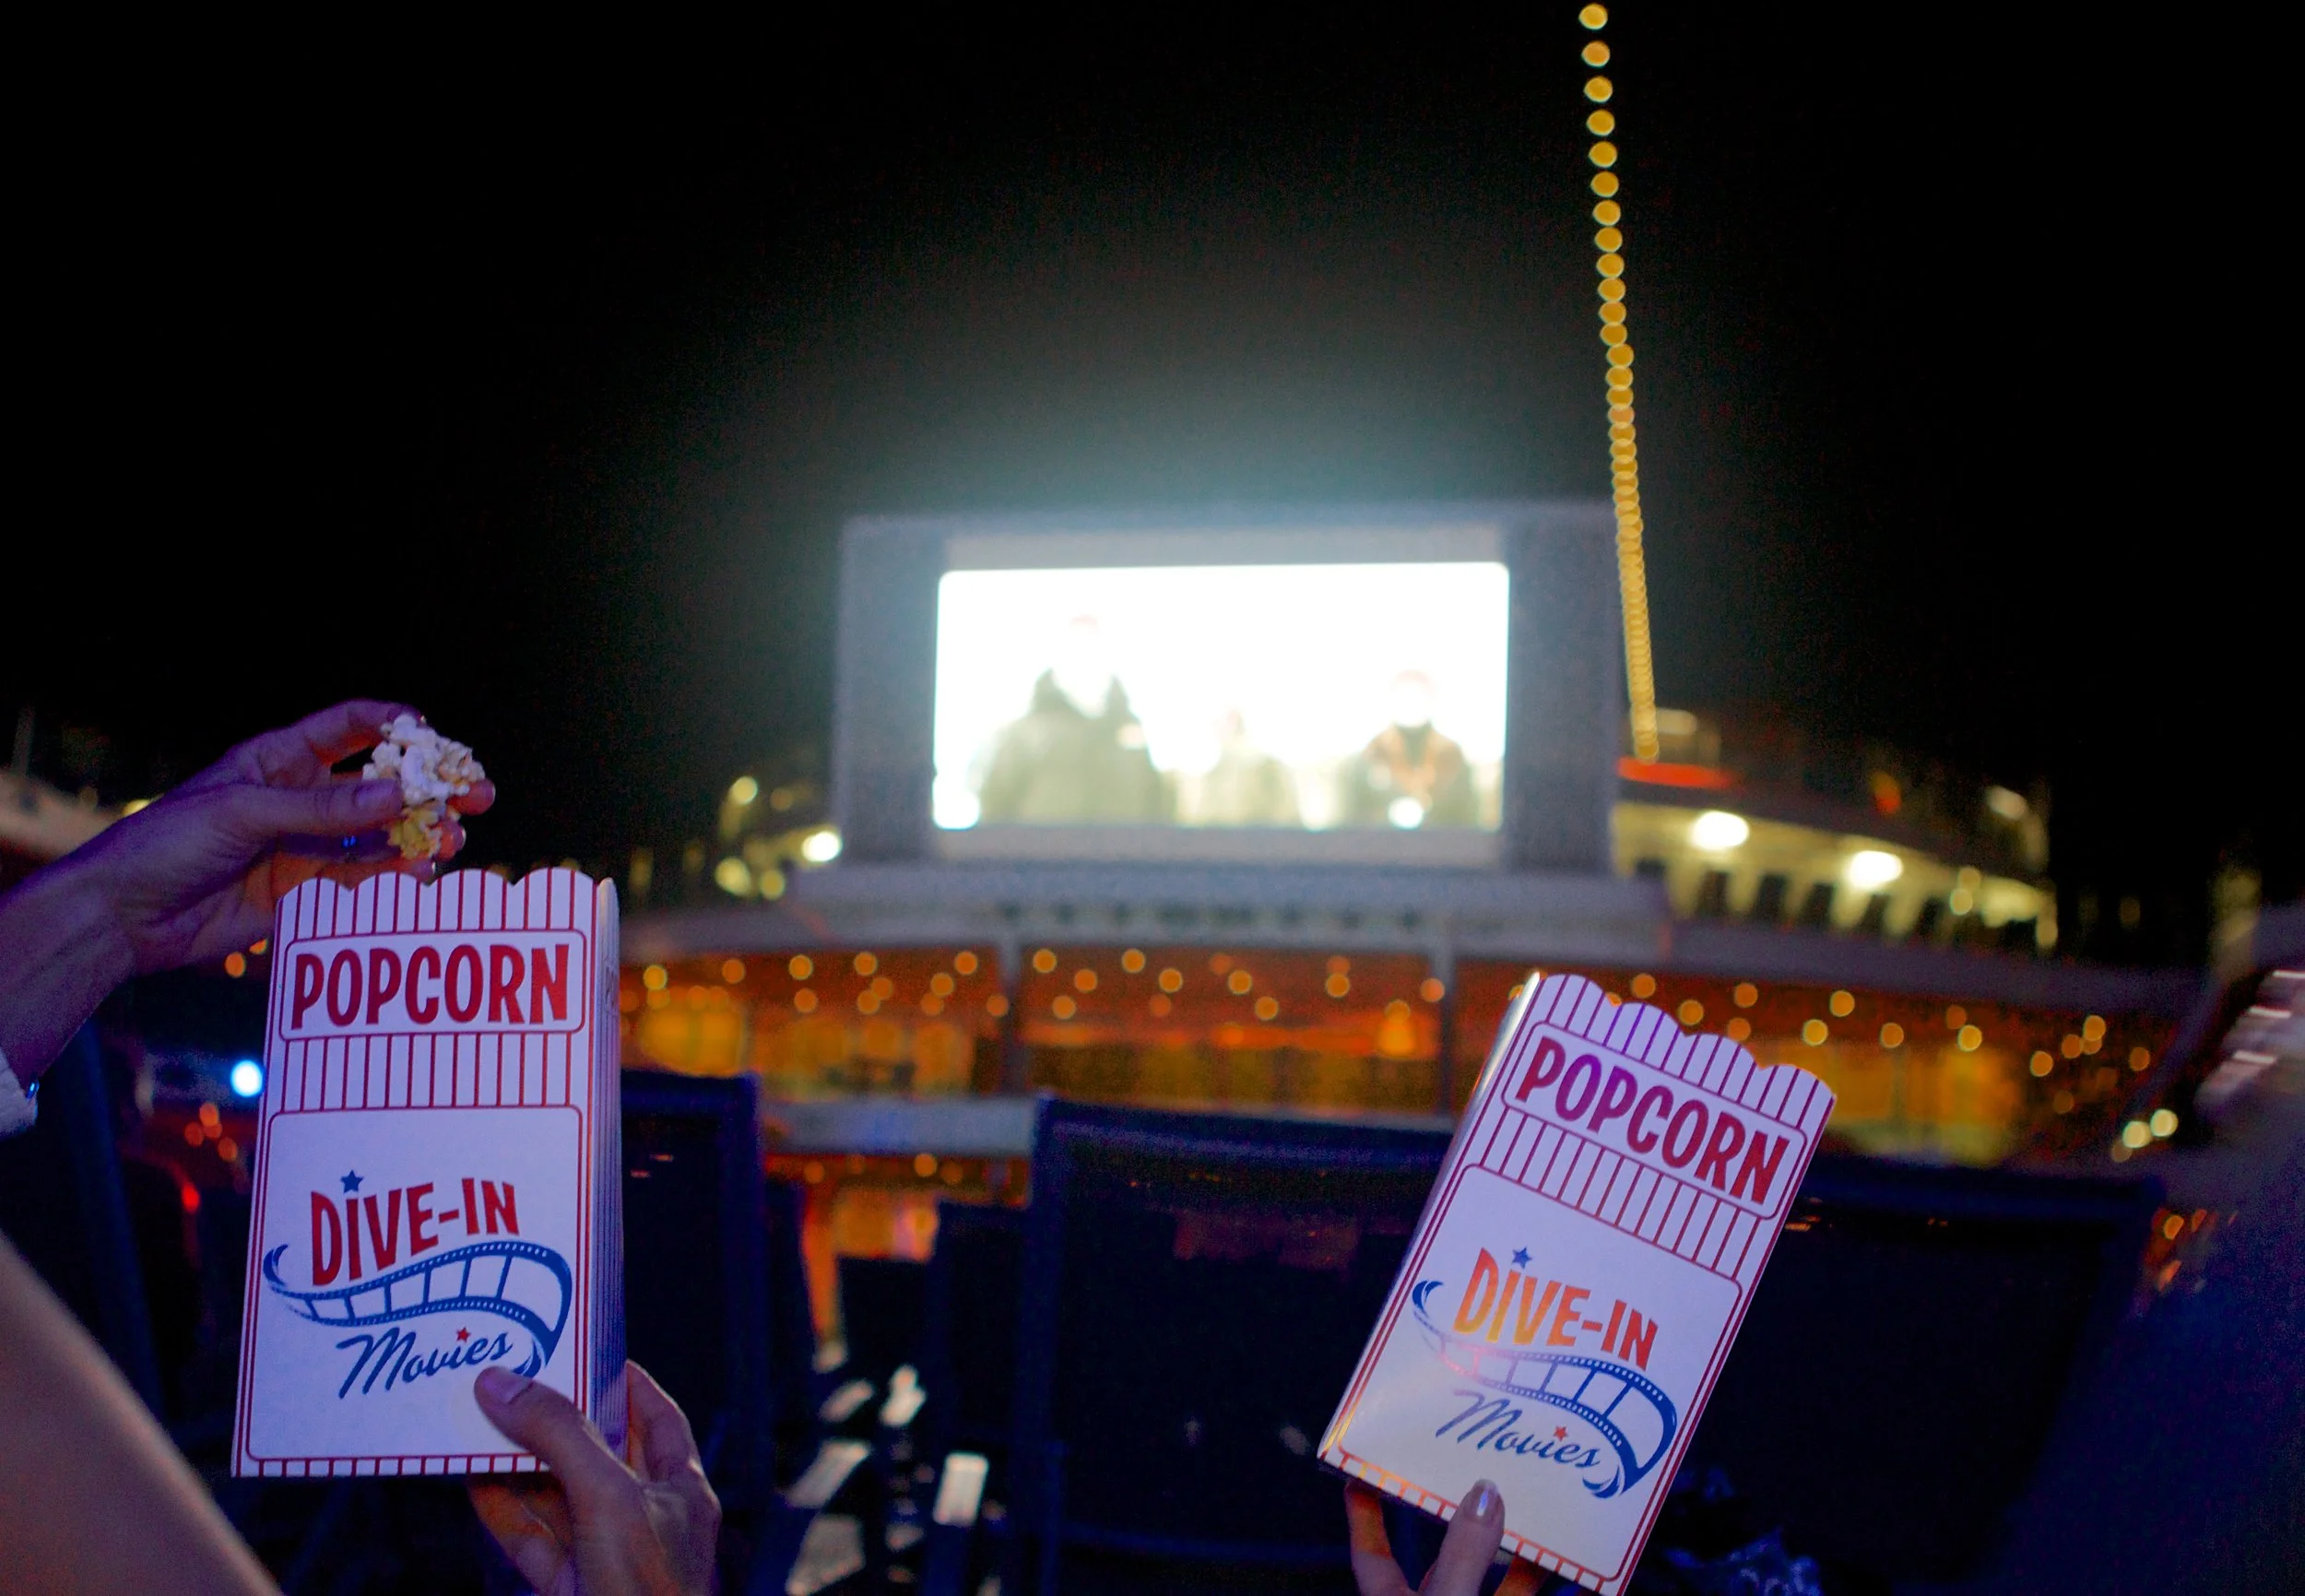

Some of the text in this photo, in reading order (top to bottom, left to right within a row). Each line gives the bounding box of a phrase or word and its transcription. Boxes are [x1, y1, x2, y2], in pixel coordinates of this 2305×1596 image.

[291, 944, 570, 1030] POPCORN
[1515, 1036, 1791, 1206] POPCORN
[336, 1327, 513, 1400] Movies
[1435, 1389, 1601, 1469] Movies
